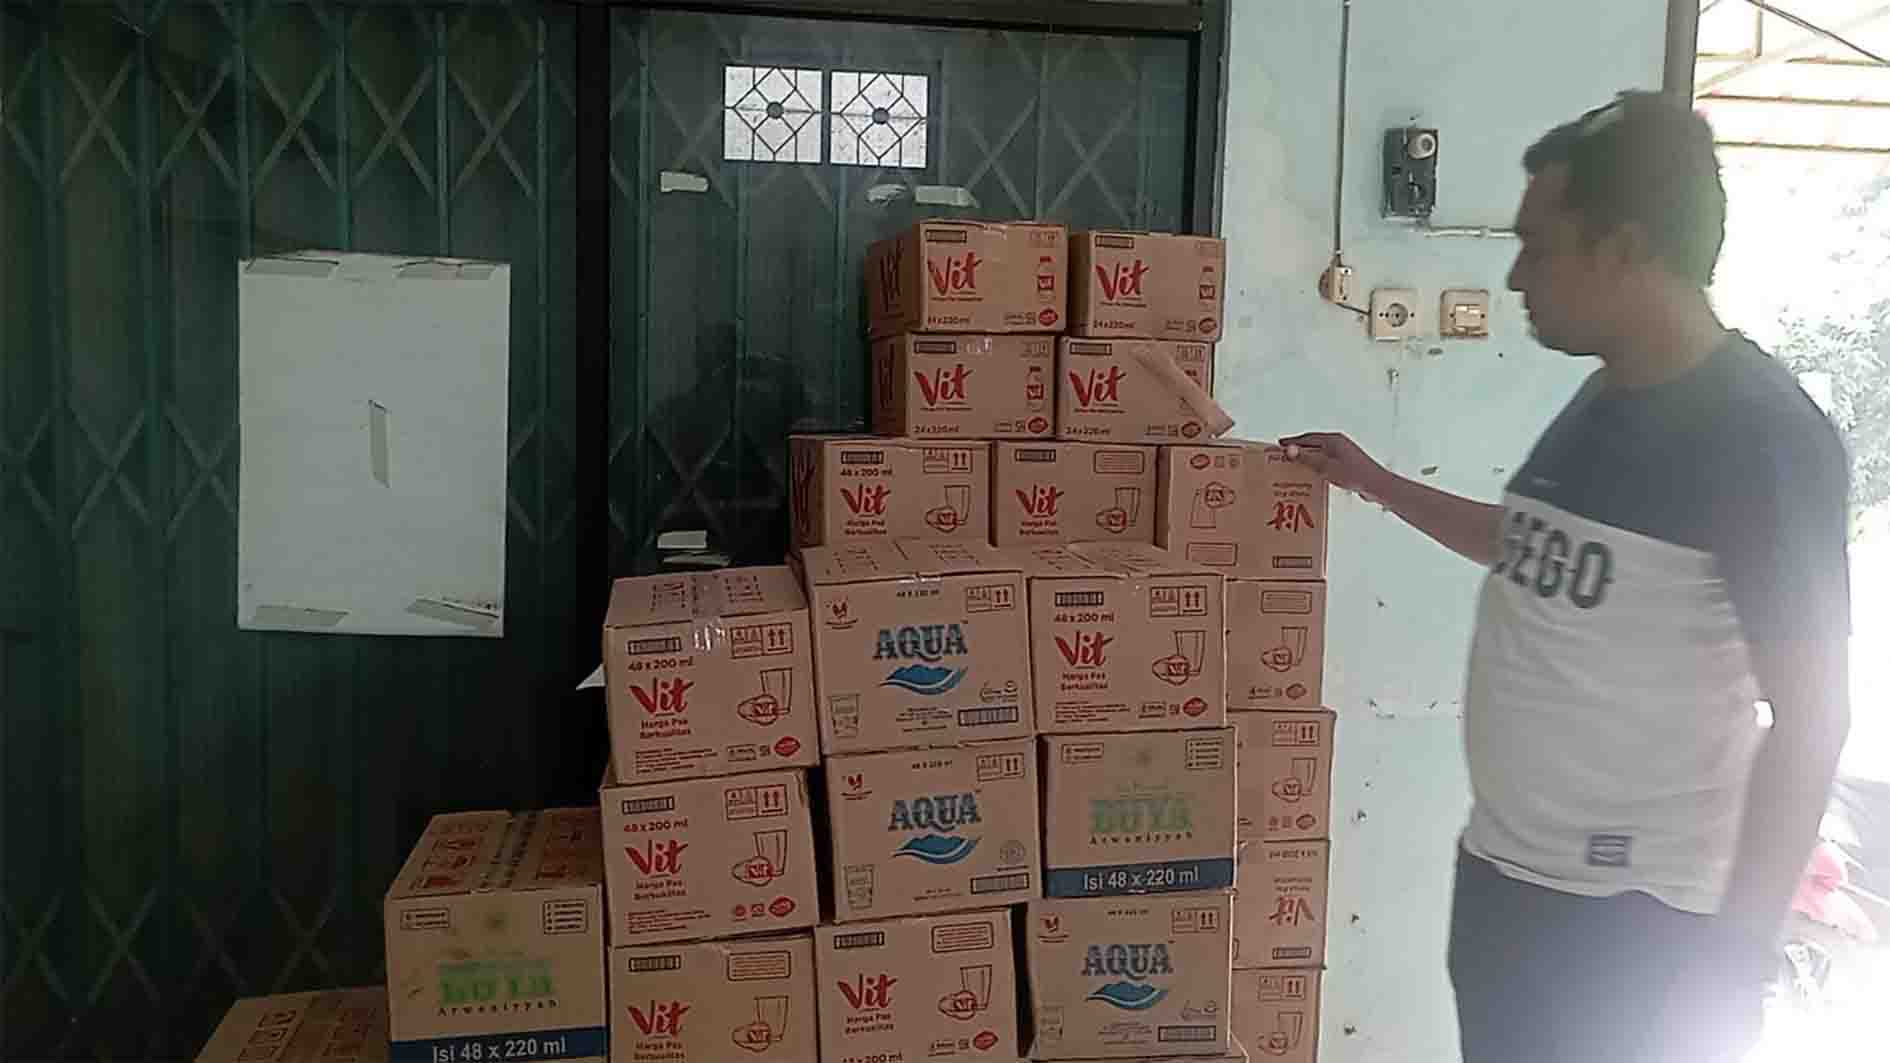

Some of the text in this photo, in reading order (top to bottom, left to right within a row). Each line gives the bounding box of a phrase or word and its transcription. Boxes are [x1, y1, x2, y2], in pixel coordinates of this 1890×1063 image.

[928, 251, 982, 296] Vit
[1096, 259, 1149, 301] Vit
[914, 364, 974, 407] Vit
[1069, 366, 1127, 407] Vit
[840, 483, 891, 515] Vit
[1016, 484, 1064, 516] Vit
[1266, 501, 1315, 533] Vit
[1077, 612, 1099, 622] 200
[1101, 611, 1114, 622] ml
[872, 624, 968, 662] AQUA
[1055, 630, 1115, 666] Vit
[653, 658, 677, 669] 200
[628, 677, 694, 715] Vit
[649, 820, 671, 831] 200
[673, 819, 688, 828] ml
[887, 792, 982, 832] AQUA
[624, 839, 688, 875] Vit
[1083, 866, 1199, 891] Isi 48 x 220 ml
[1081, 943, 1174, 981] AQUA
[837, 973, 897, 1010] Vit
[627, 999, 691, 1038] Vit
[432, 1034, 566, 1063] Isi 48 x 220 ml
